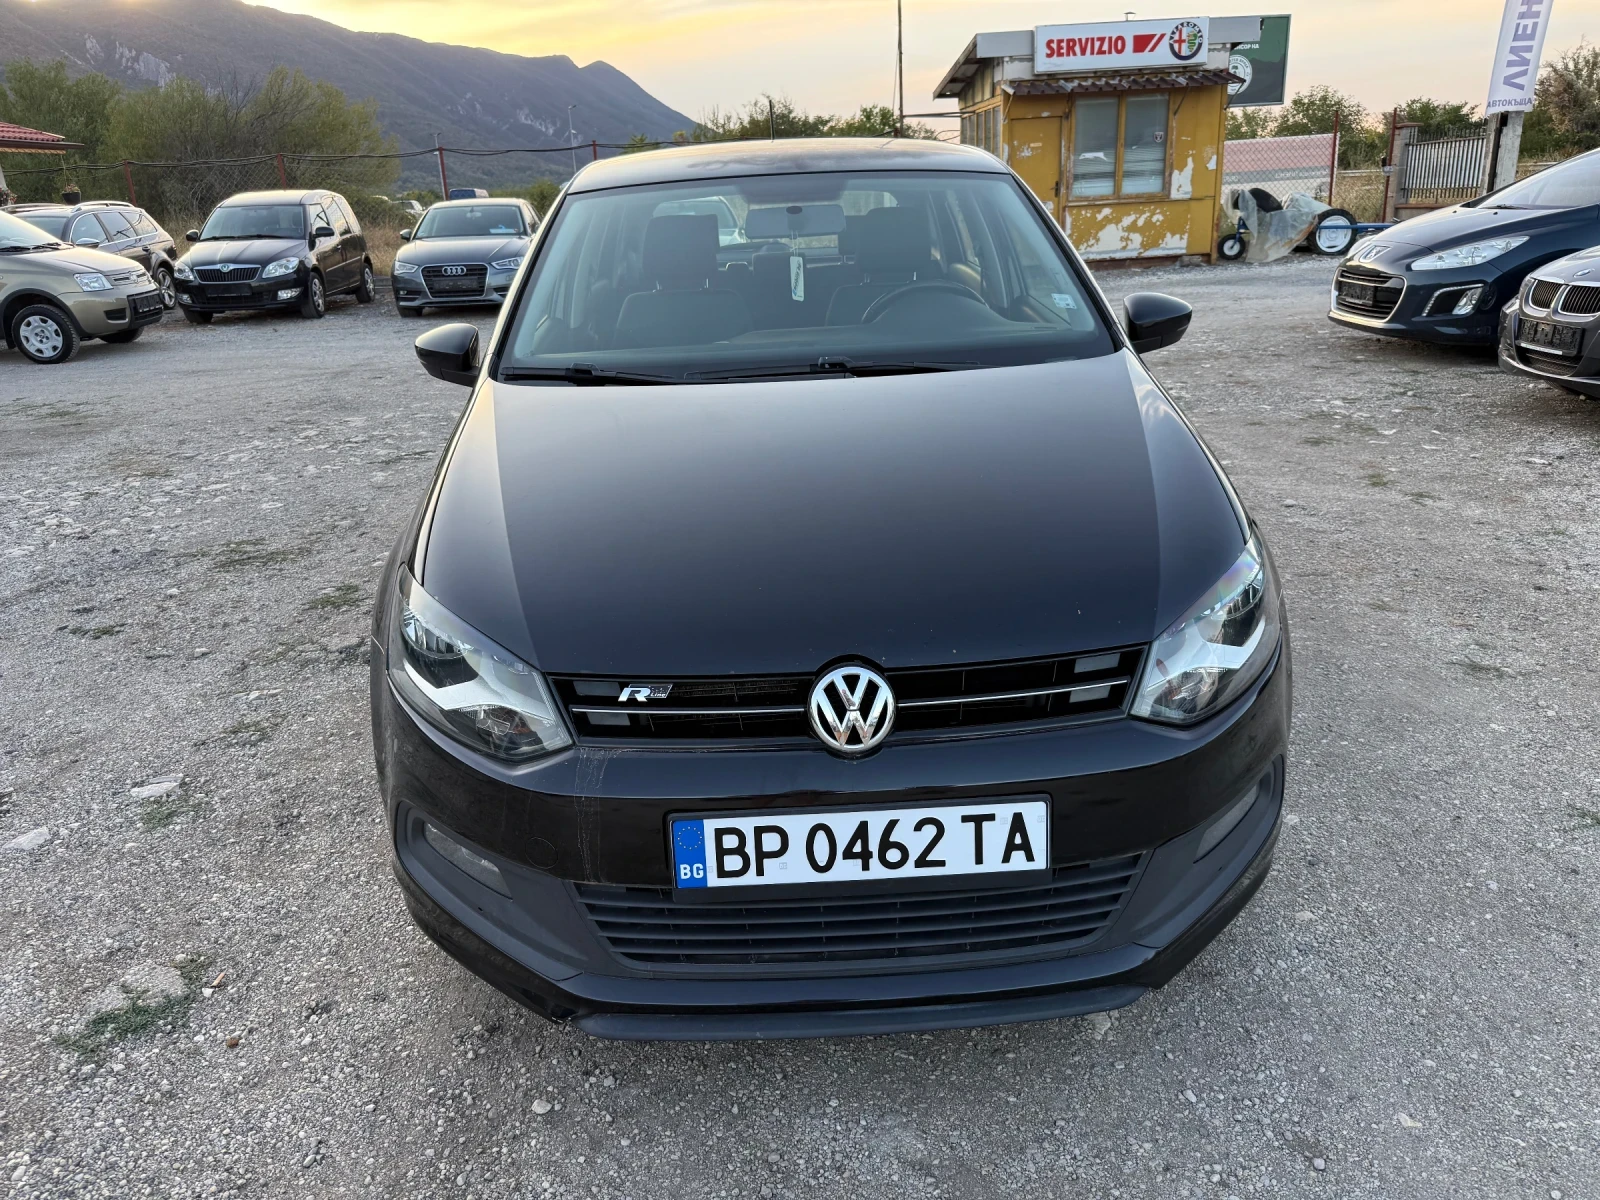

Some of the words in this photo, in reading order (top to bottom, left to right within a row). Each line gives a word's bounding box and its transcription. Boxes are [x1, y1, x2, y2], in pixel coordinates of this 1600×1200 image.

[1045, 35, 1126, 58] SERVIZIO
[1486, 97, 1533, 108] АВТОКЪЩА
[618, 687, 651, 702] R
[714, 825, 789, 879] BP
[805, 816, 947, 874] 0462
[960, 811, 1035, 865] TA
[679, 863, 704, 880] BG
